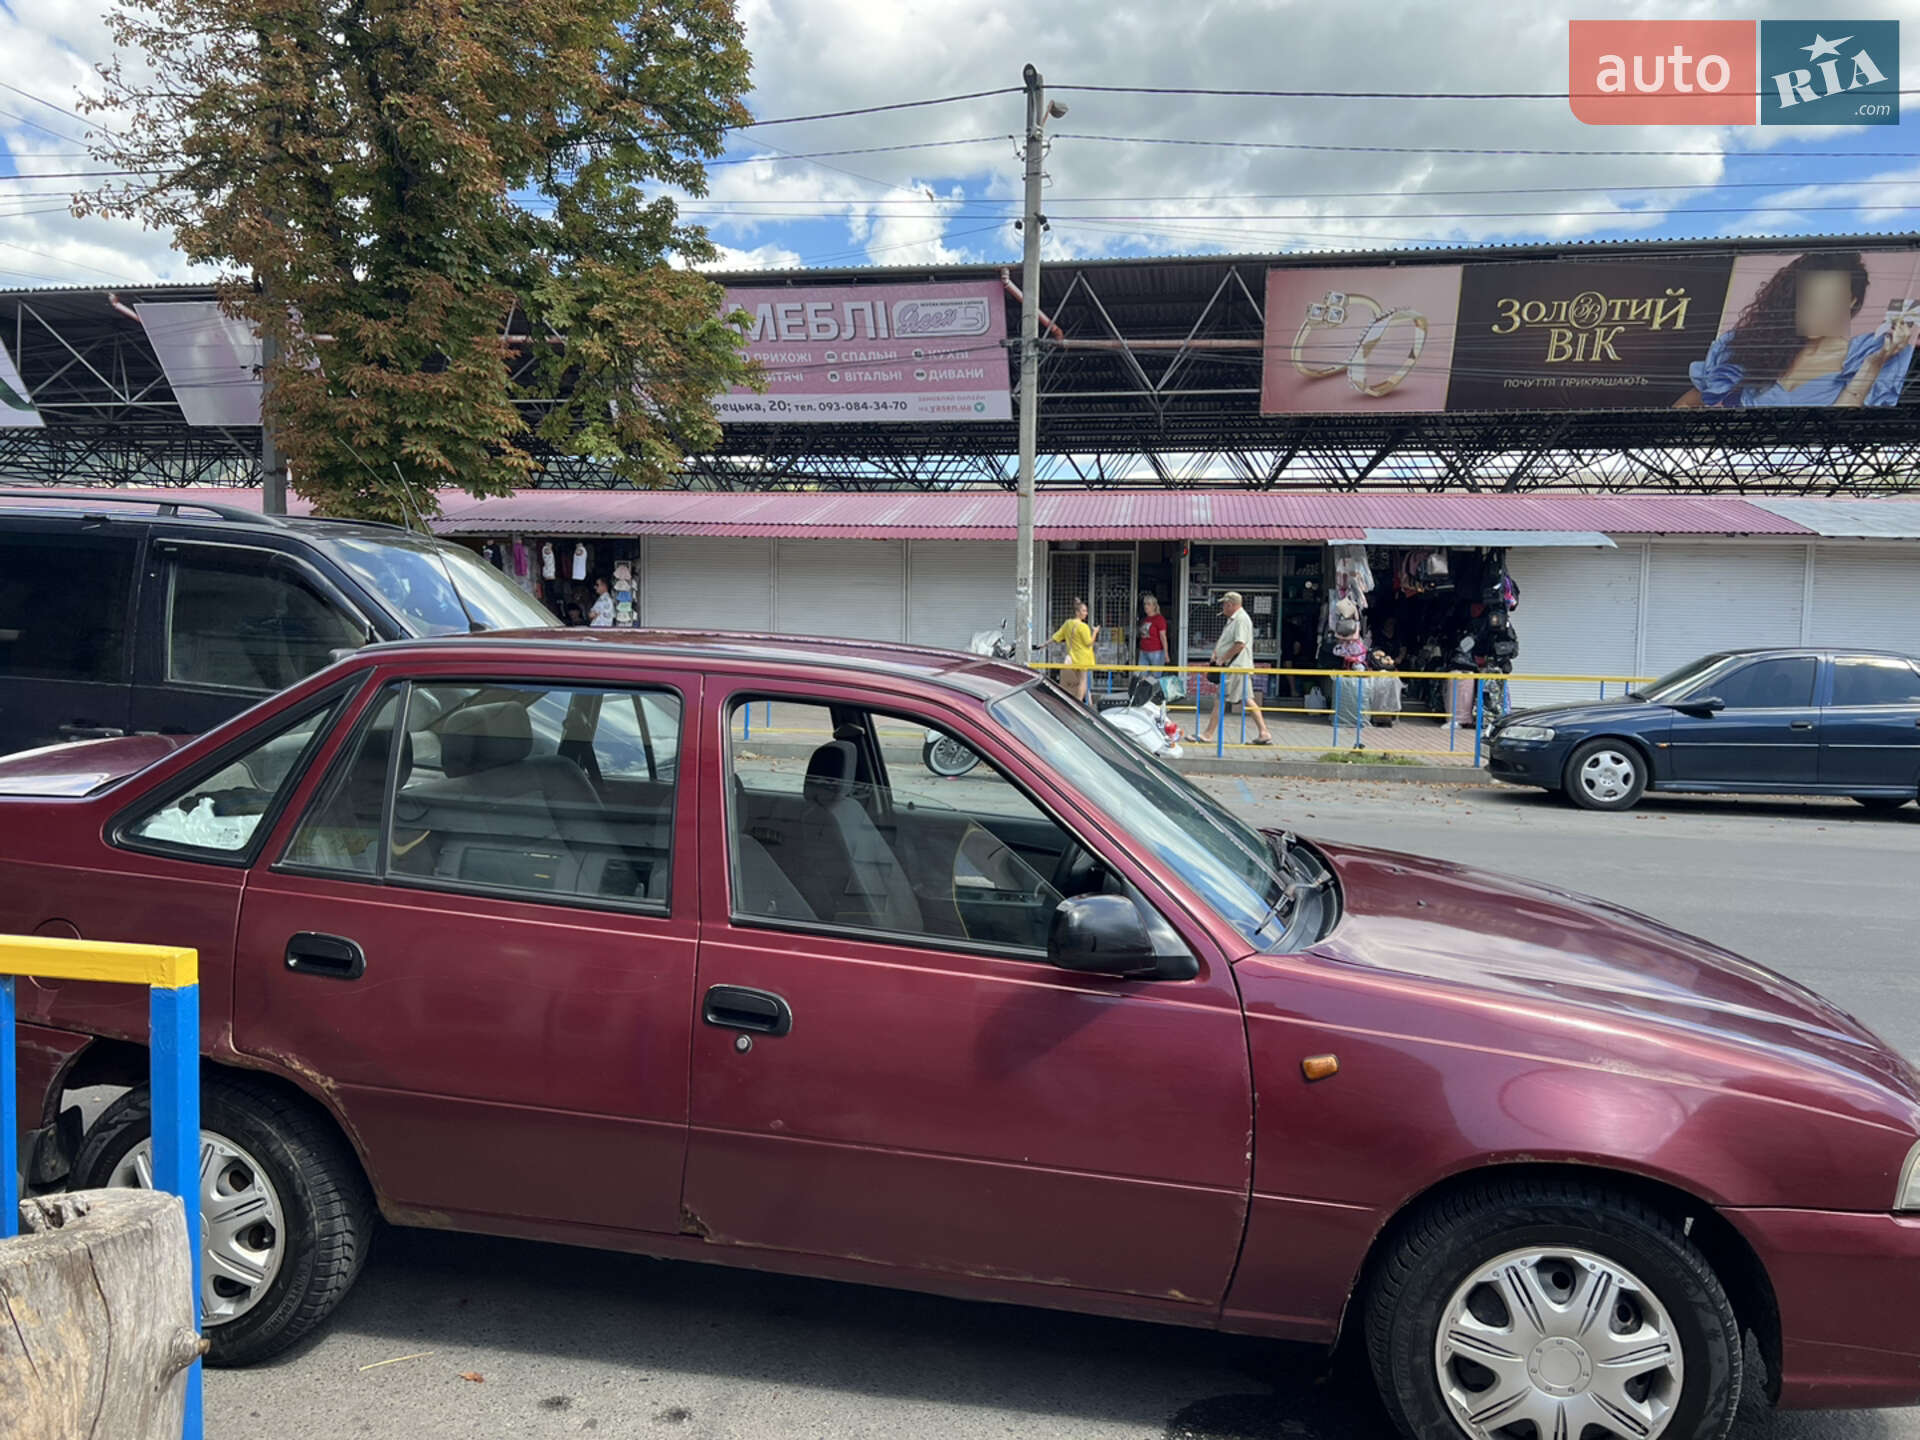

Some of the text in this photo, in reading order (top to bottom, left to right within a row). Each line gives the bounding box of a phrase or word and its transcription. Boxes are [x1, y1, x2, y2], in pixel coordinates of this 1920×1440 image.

[728, 301, 890, 342] МЕБЛІ
[1545, 325, 1625, 362] ВІК
[753, 351, 812, 363] ПРИХОЖІ
[841, 350, 897, 362] СПАЛЬНІ
[759, 371, 804, 383] ИТЯЧІ
[844, 370, 903, 382] ВІТАЛЬНІ
[928, 368, 984, 382] ДИВАНИ
[1503, 375, 1649, 388] ПОЧУТТЯ ПРИКРАШАЮТЬ
[712, 402, 766, 414] рецька,
[794, 403, 817, 412] тел.
[818, 401, 908, 412] 093-084-34-70
